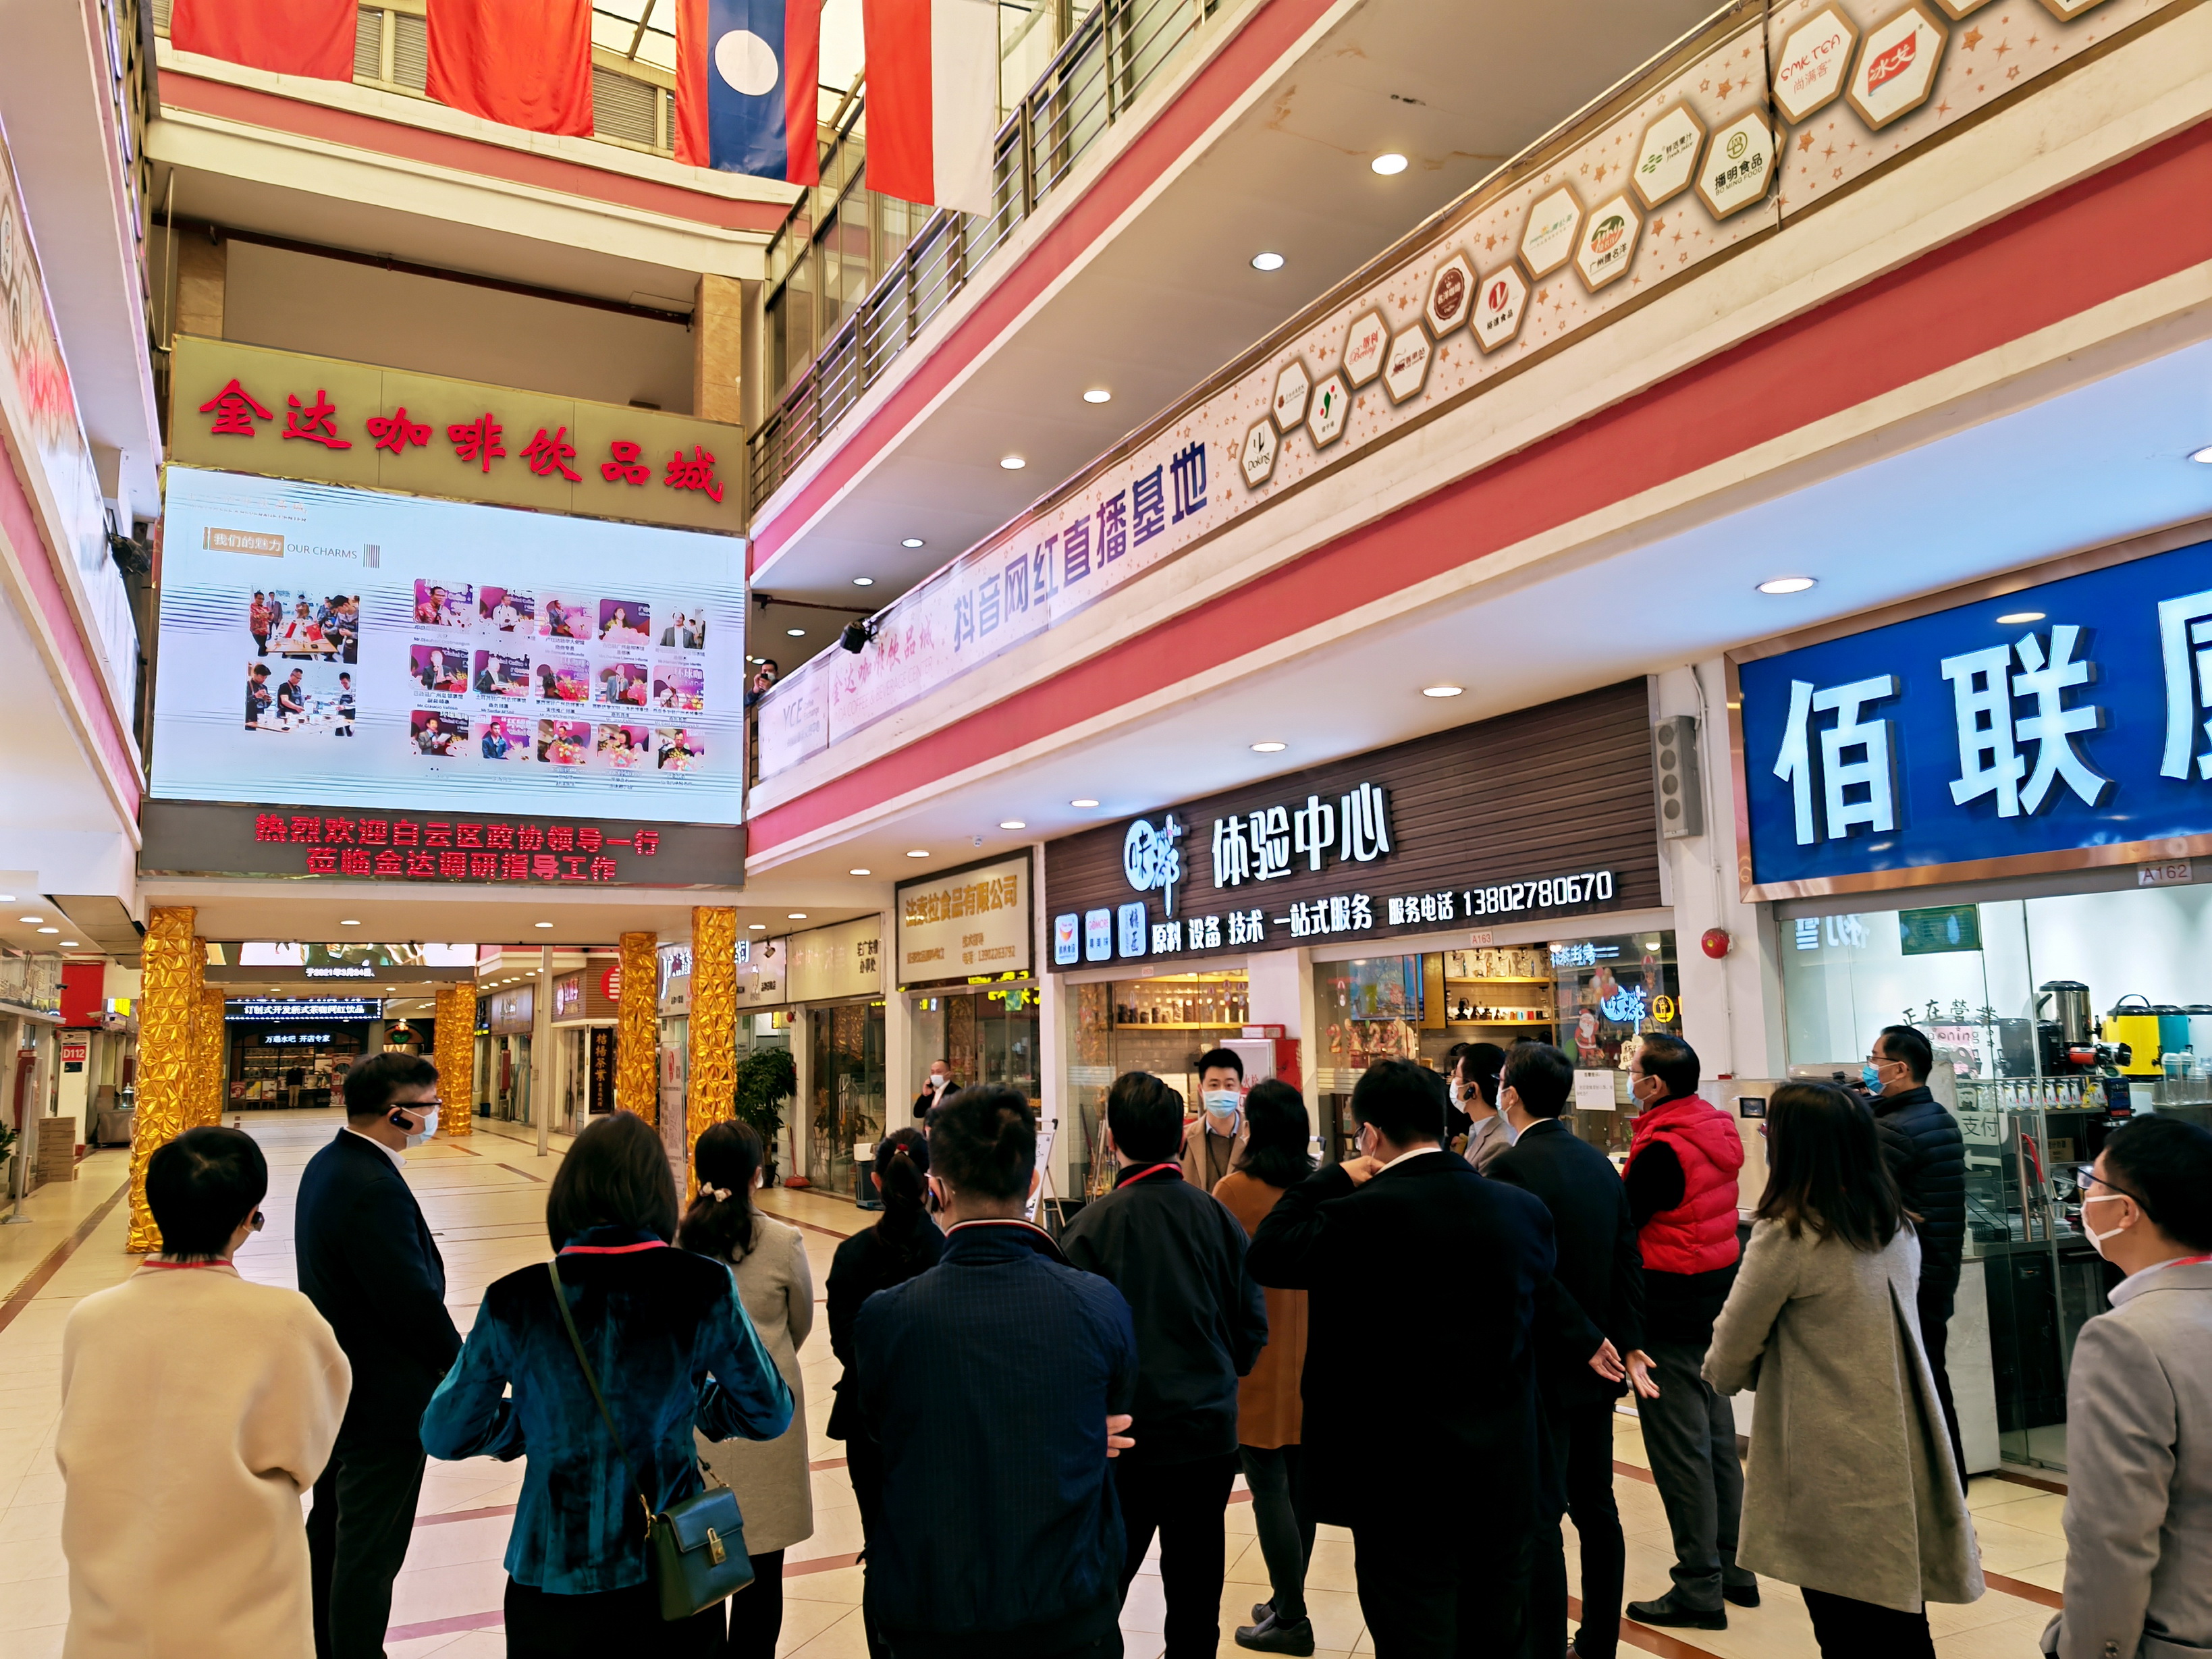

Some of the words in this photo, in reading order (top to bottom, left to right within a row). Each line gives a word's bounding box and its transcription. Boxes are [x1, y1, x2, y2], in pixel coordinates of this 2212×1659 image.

[1793, 62, 1829, 94] 尚满客
[1715, 153, 1763, 190] 播明食品
[1725, 178, 1743, 190] MING
[1743, 165, 1763, 180] FOOD
[199, 378, 725, 503] 金达咖啡饮品城
[213, 533, 281, 552] 我们的魅力
[286, 543, 311, 554] OUR
[312, 547, 358, 560] CHARMS
[952, 440, 1208, 654] 抖音网红直播基地
[783, 697, 803, 731] YCE
[254, 813, 662, 856] 热烈欢迎白云区政协领导一行
[1212, 782, 1391, 889] 体验中心
[306, 846, 618, 882] 莅临金达调研指导工作
[2142, 864, 2188, 881] A162
[1151, 921, 1182, 954] 原料
[1188, 916, 1222, 950] 设备
[1228, 908, 1264, 944] 技术
[1272, 893, 1373, 939] 一站式服务
[1388, 891, 1454, 926] 服务电话
[1463, 870, 1613, 917] 13802780670
[1472, 933, 1492, 944] A163
[63, 1048, 85, 1059] D112
[1961, 1116, 1999, 1138] 支付
